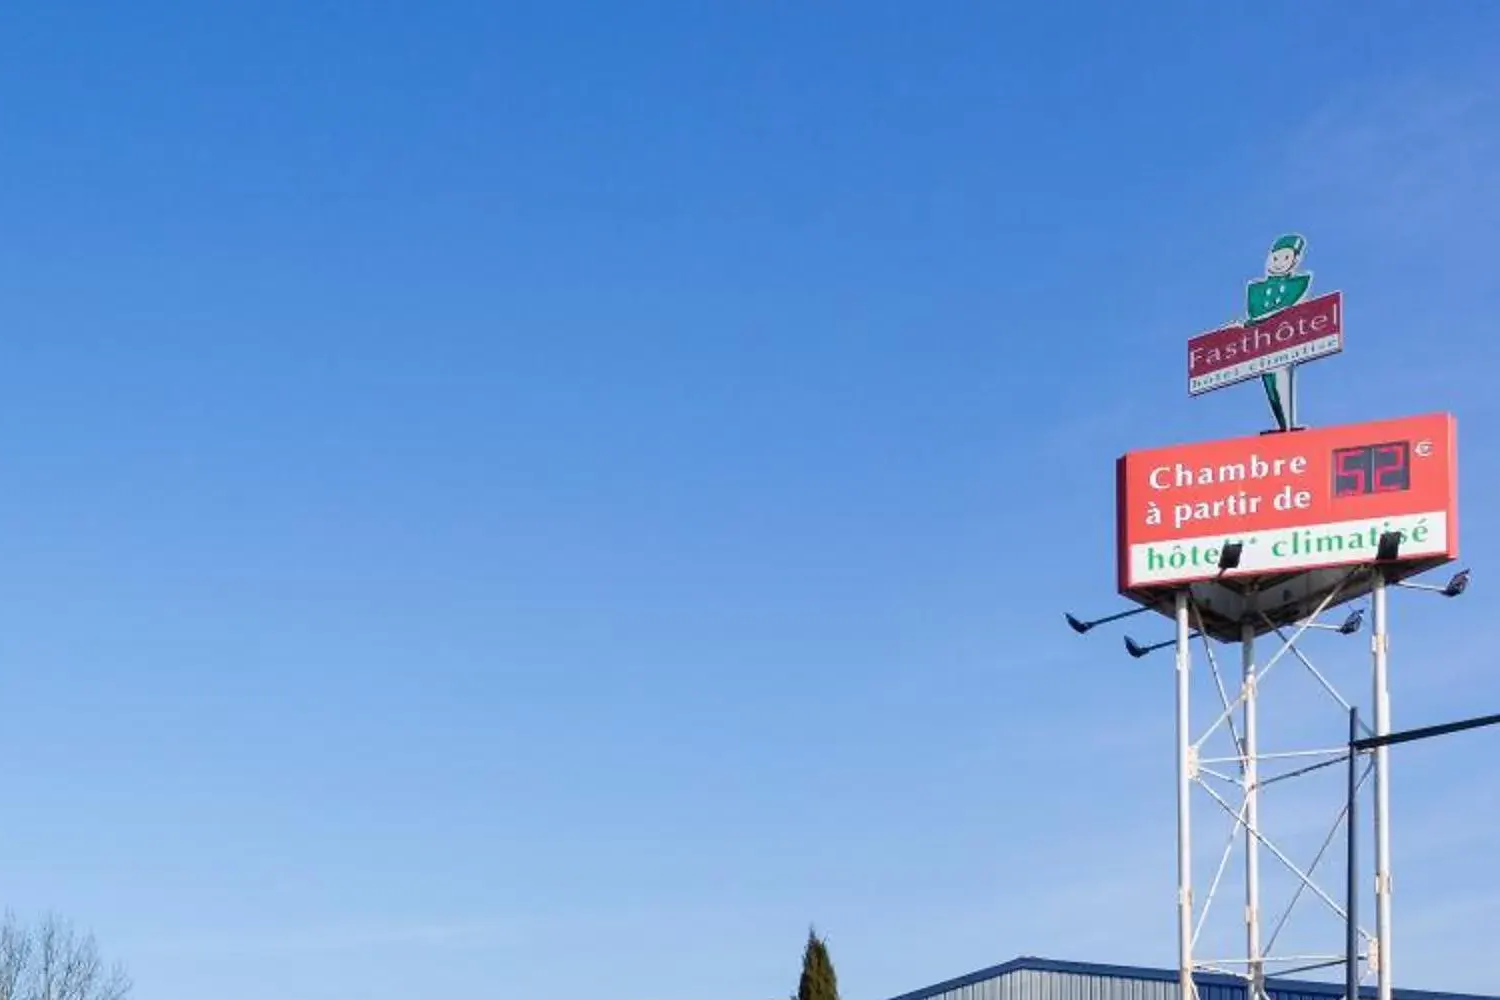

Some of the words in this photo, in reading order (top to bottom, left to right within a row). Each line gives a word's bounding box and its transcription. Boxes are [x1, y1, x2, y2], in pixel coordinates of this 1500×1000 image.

[1190, 303, 1337, 369] Fasthôtel
[1414, 441, 1434, 457] €
[1149, 454, 1307, 490] Chambre
[1336, 448, 1403, 495] 52
[1145, 502, 1161, 525] à
[1174, 489, 1262, 528] partir
[1273, 486, 1311, 511] de
[1146, 538, 1231, 570] hôte
